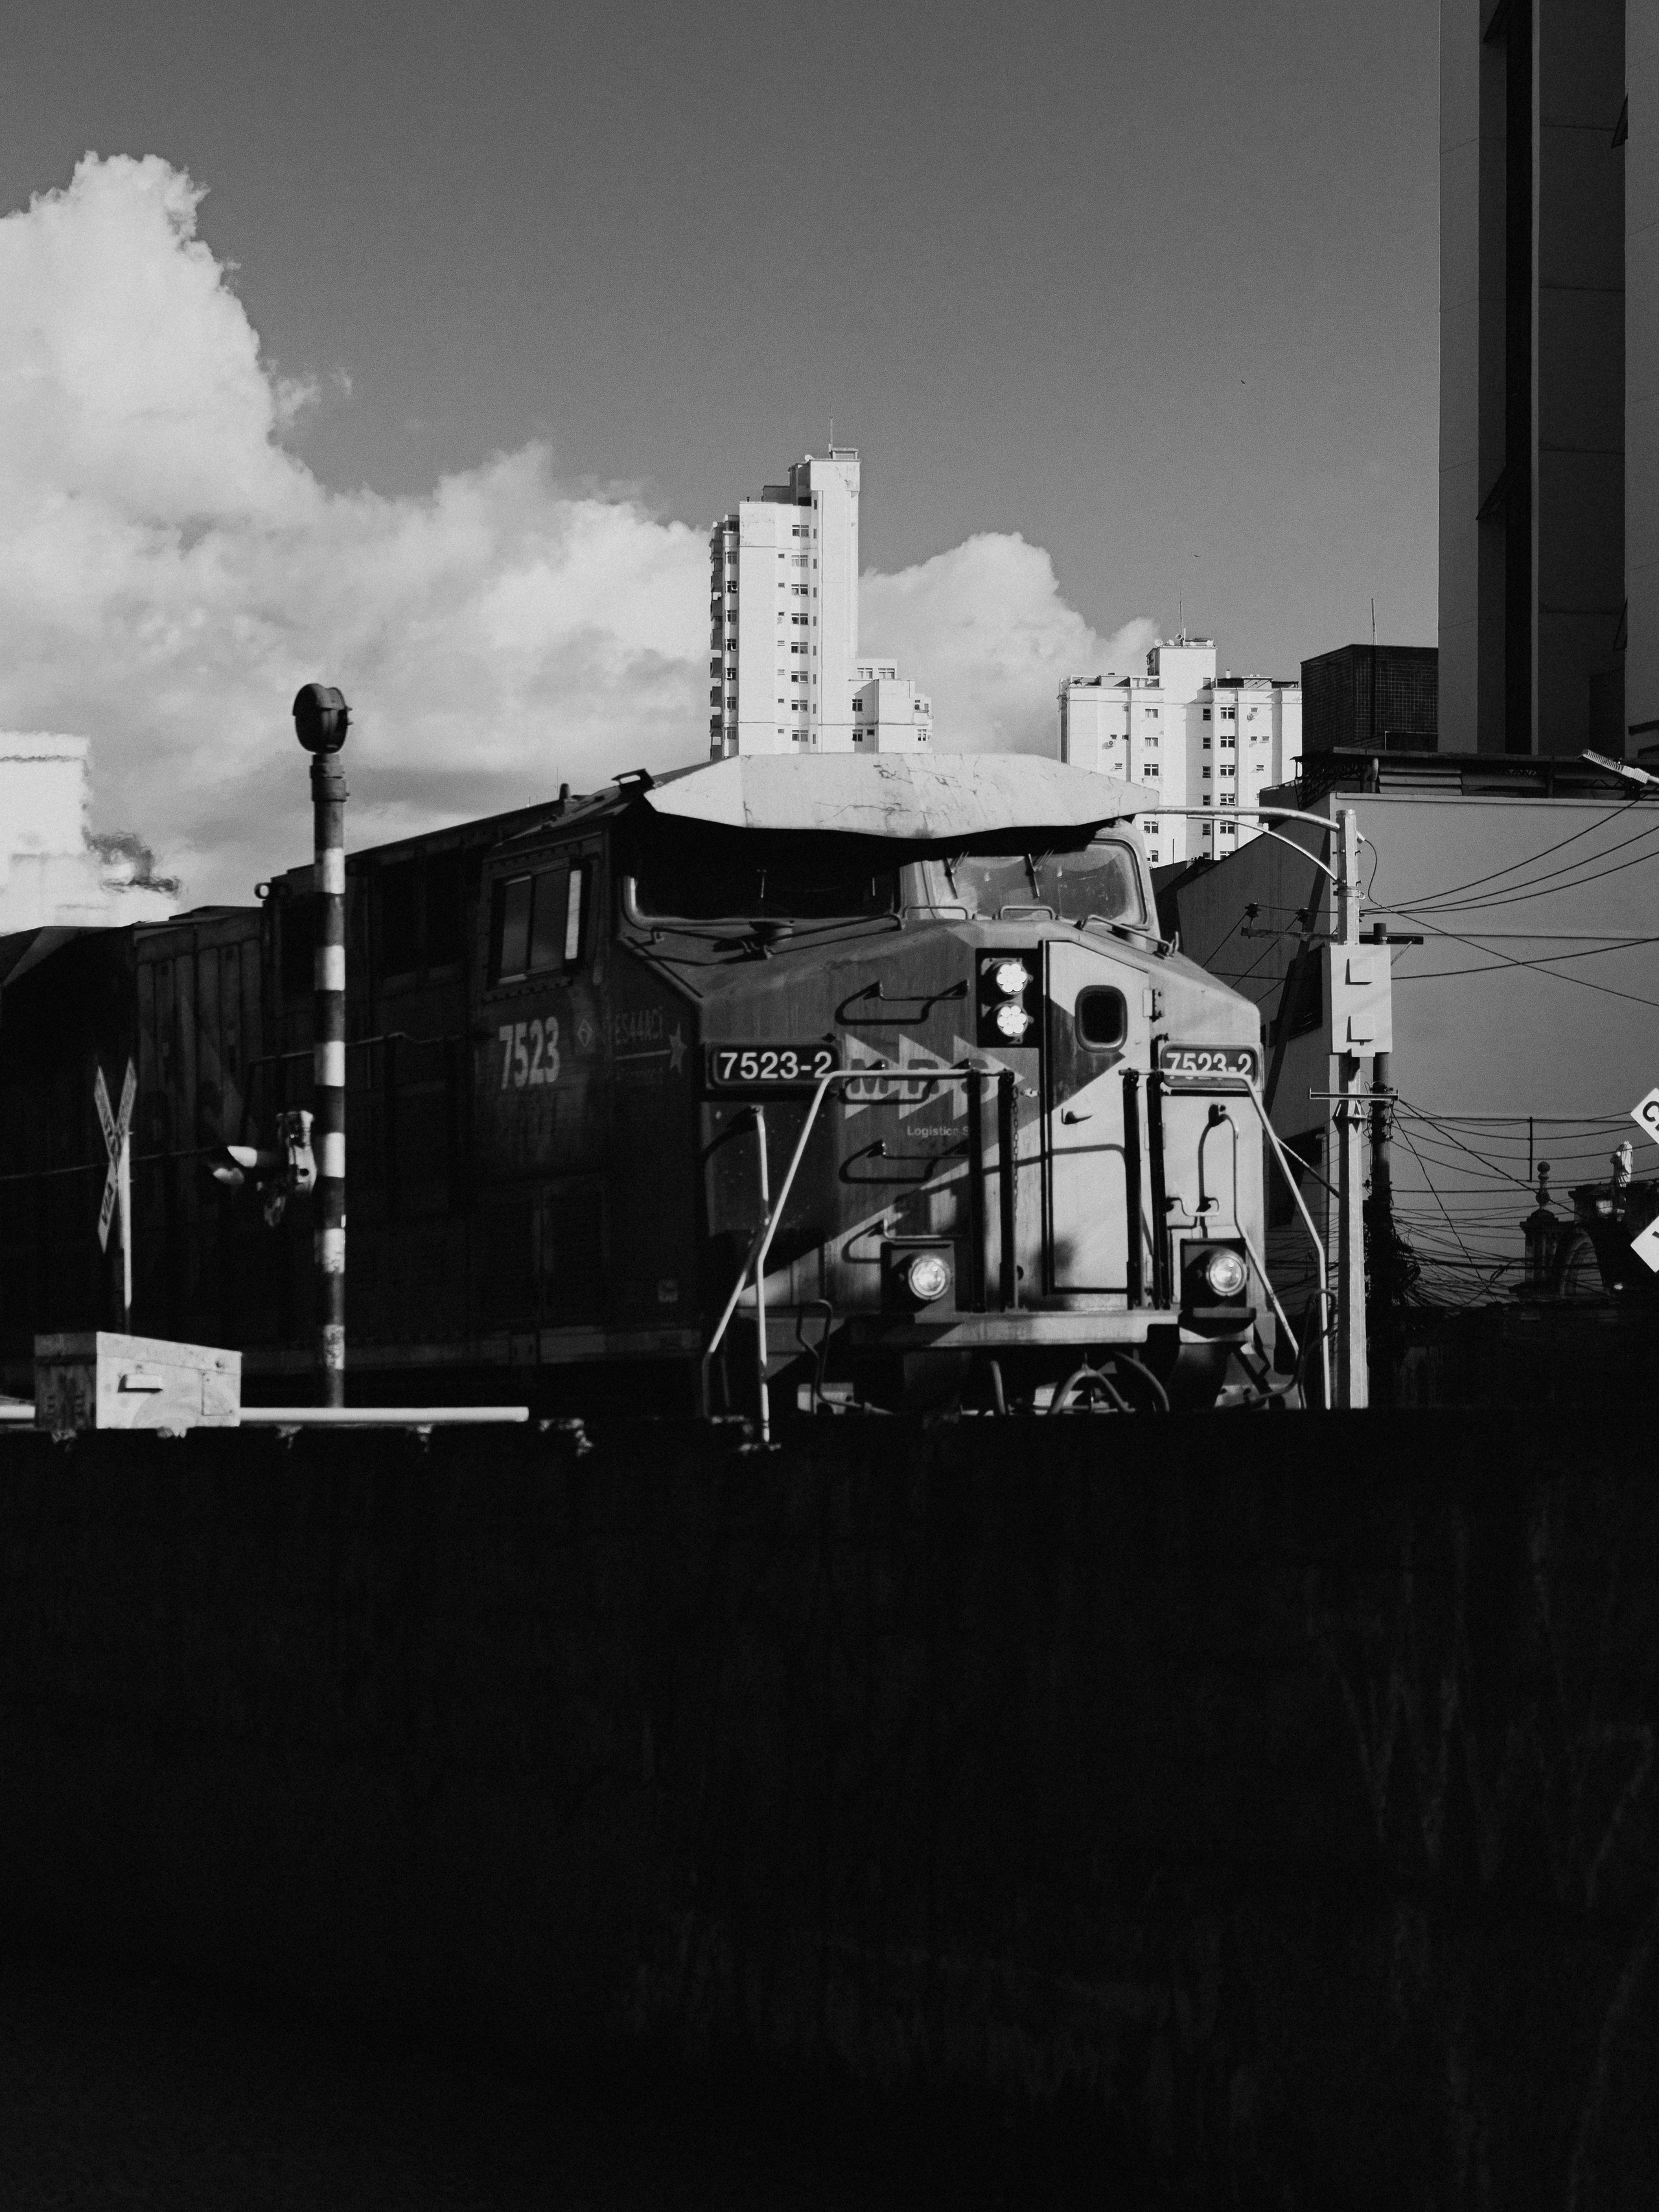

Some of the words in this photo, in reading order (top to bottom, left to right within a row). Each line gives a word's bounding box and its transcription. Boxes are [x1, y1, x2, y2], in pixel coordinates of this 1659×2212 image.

[498, 1016, 561, 1090] 7523
[719, 1051, 833, 1080] 7523-2
[1166, 1052, 1252, 1080] 7523-2
